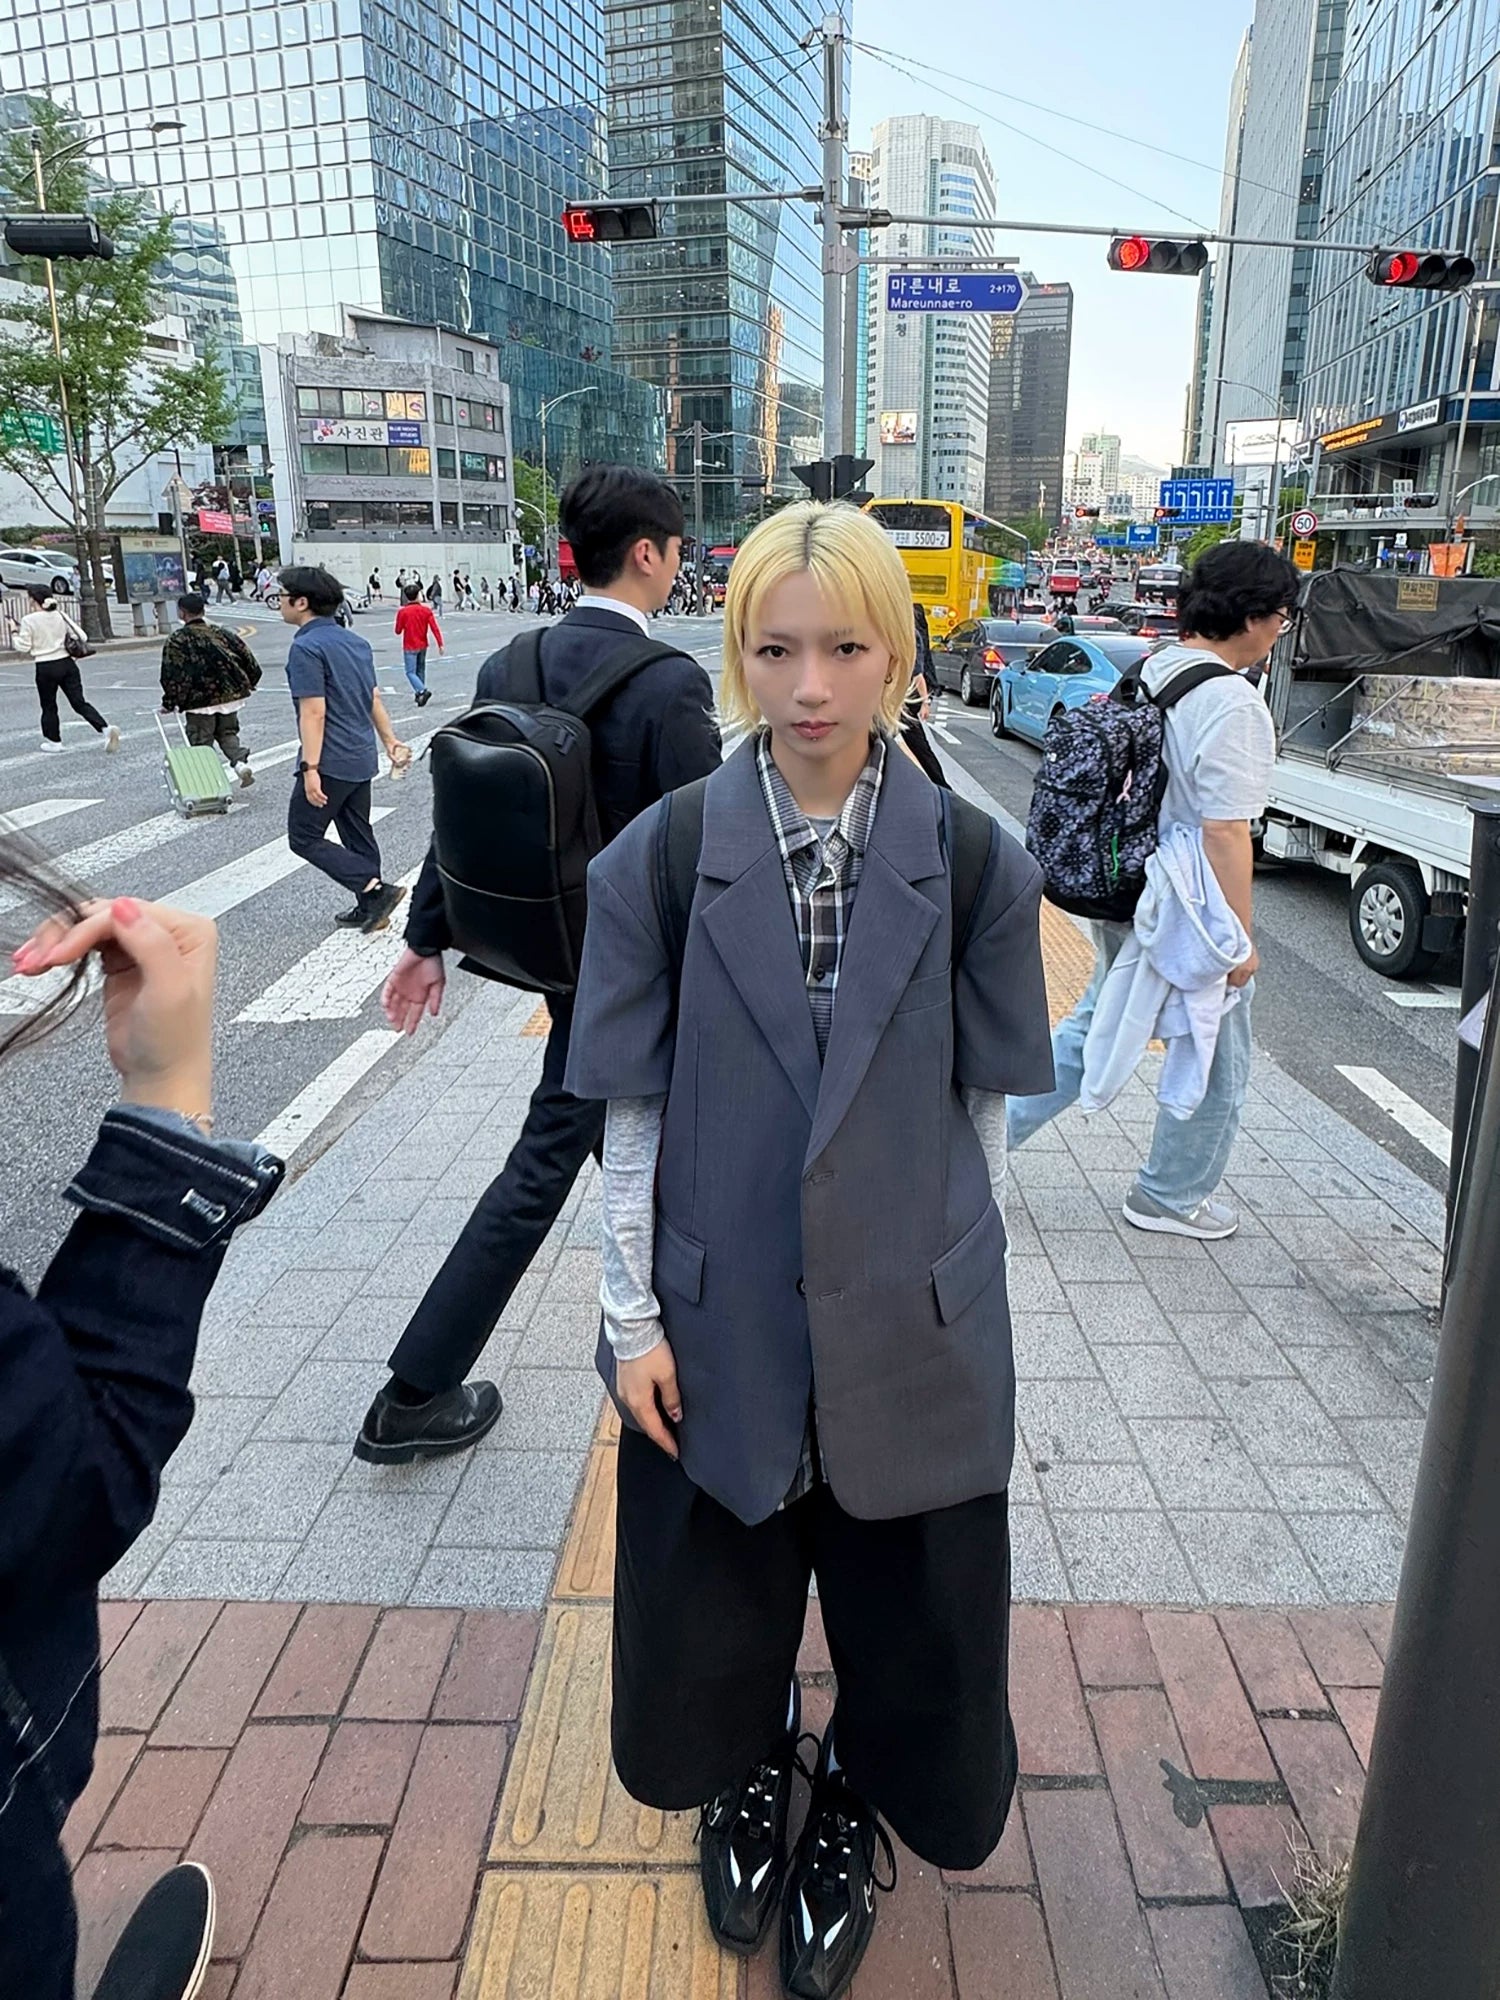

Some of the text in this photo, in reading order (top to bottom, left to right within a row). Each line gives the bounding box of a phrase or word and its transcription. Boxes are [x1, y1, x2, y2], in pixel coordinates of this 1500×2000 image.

[891, 277, 961, 295] 마른내로
[890, 298, 973, 309] Mareunnae-ro
[337, 426, 384, 441] 사진관
[1297, 517, 1312, 530] 50
[915, 532, 946, 546] 5500-2
